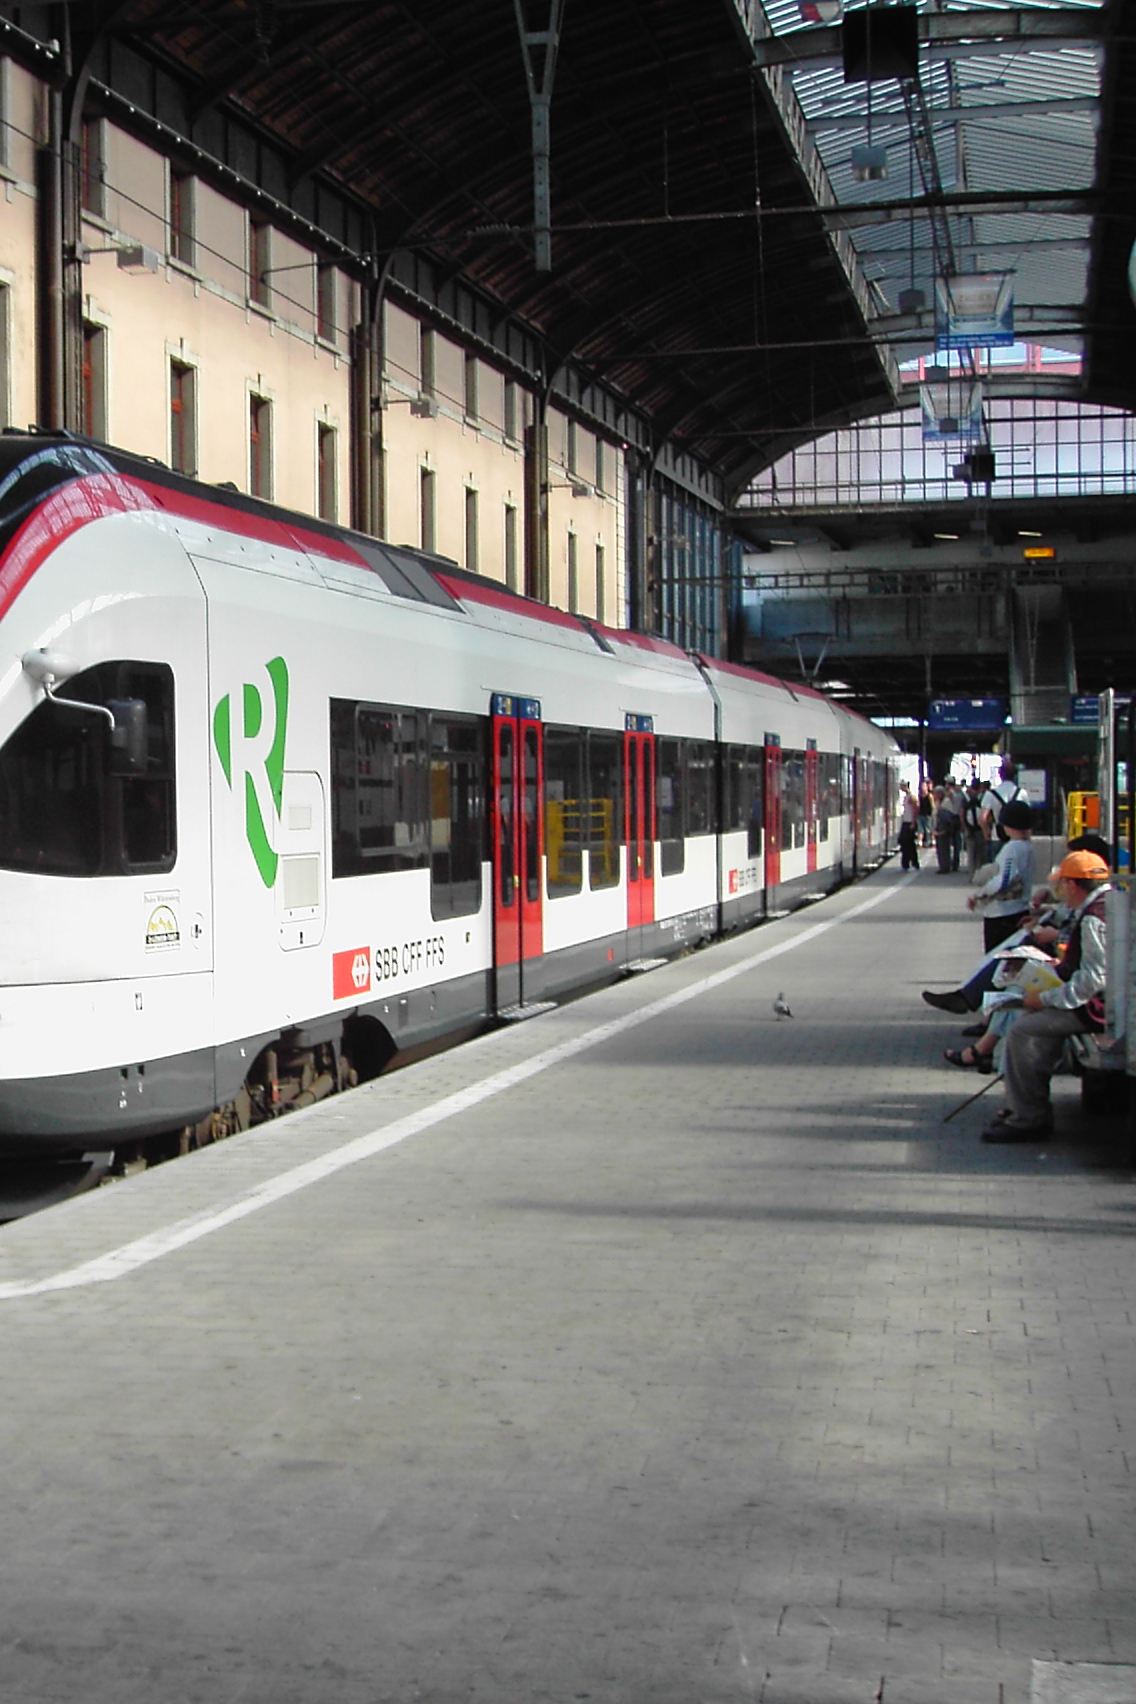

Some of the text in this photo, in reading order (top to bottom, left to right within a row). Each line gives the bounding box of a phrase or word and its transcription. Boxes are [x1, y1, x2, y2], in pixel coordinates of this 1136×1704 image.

[375, 935, 445, 982] SBB CFF FFS
